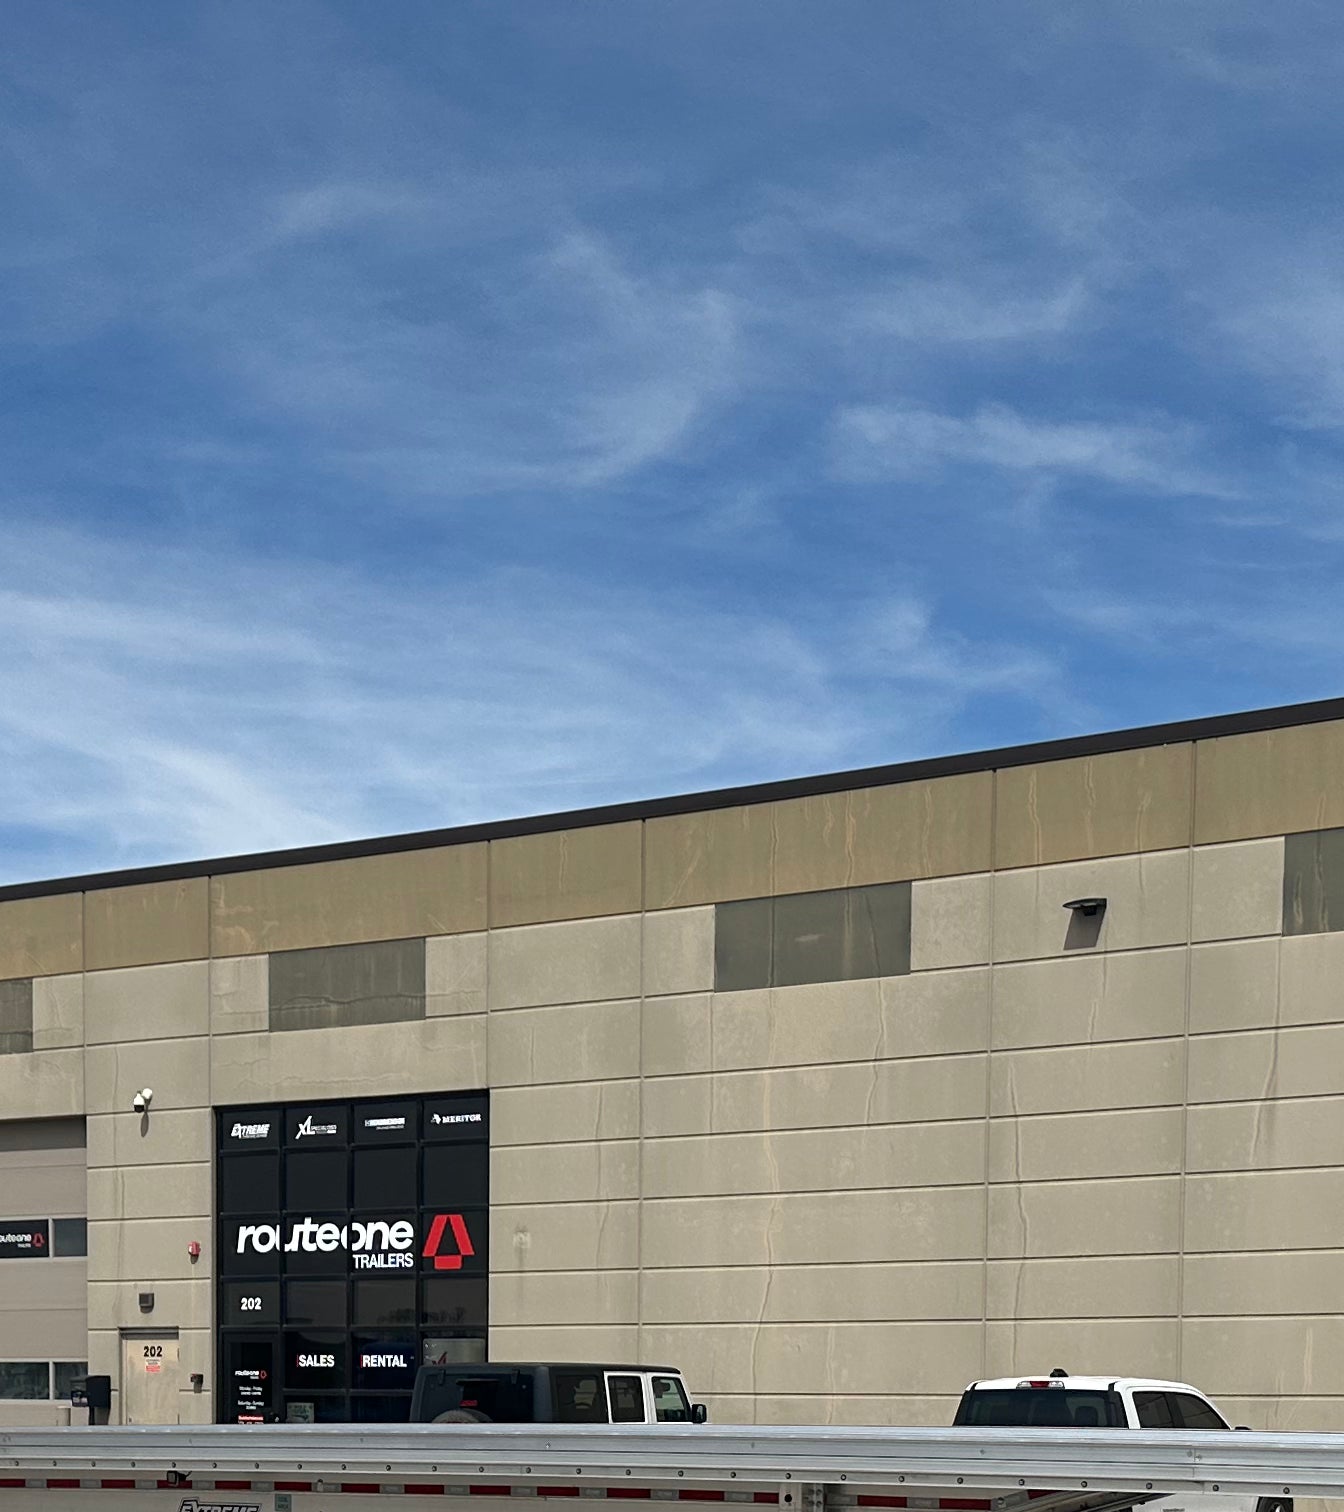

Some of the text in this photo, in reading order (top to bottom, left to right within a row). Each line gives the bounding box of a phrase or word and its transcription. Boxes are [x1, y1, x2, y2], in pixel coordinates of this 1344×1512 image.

[236, 1217, 414, 1254] routeone
[352, 1253, 414, 1269] TRAILERS
[240, 1297, 262, 1311] 202
[143, 1346, 163, 1357] 202
[298, 1354, 407, 1368] SALES RENTAL
